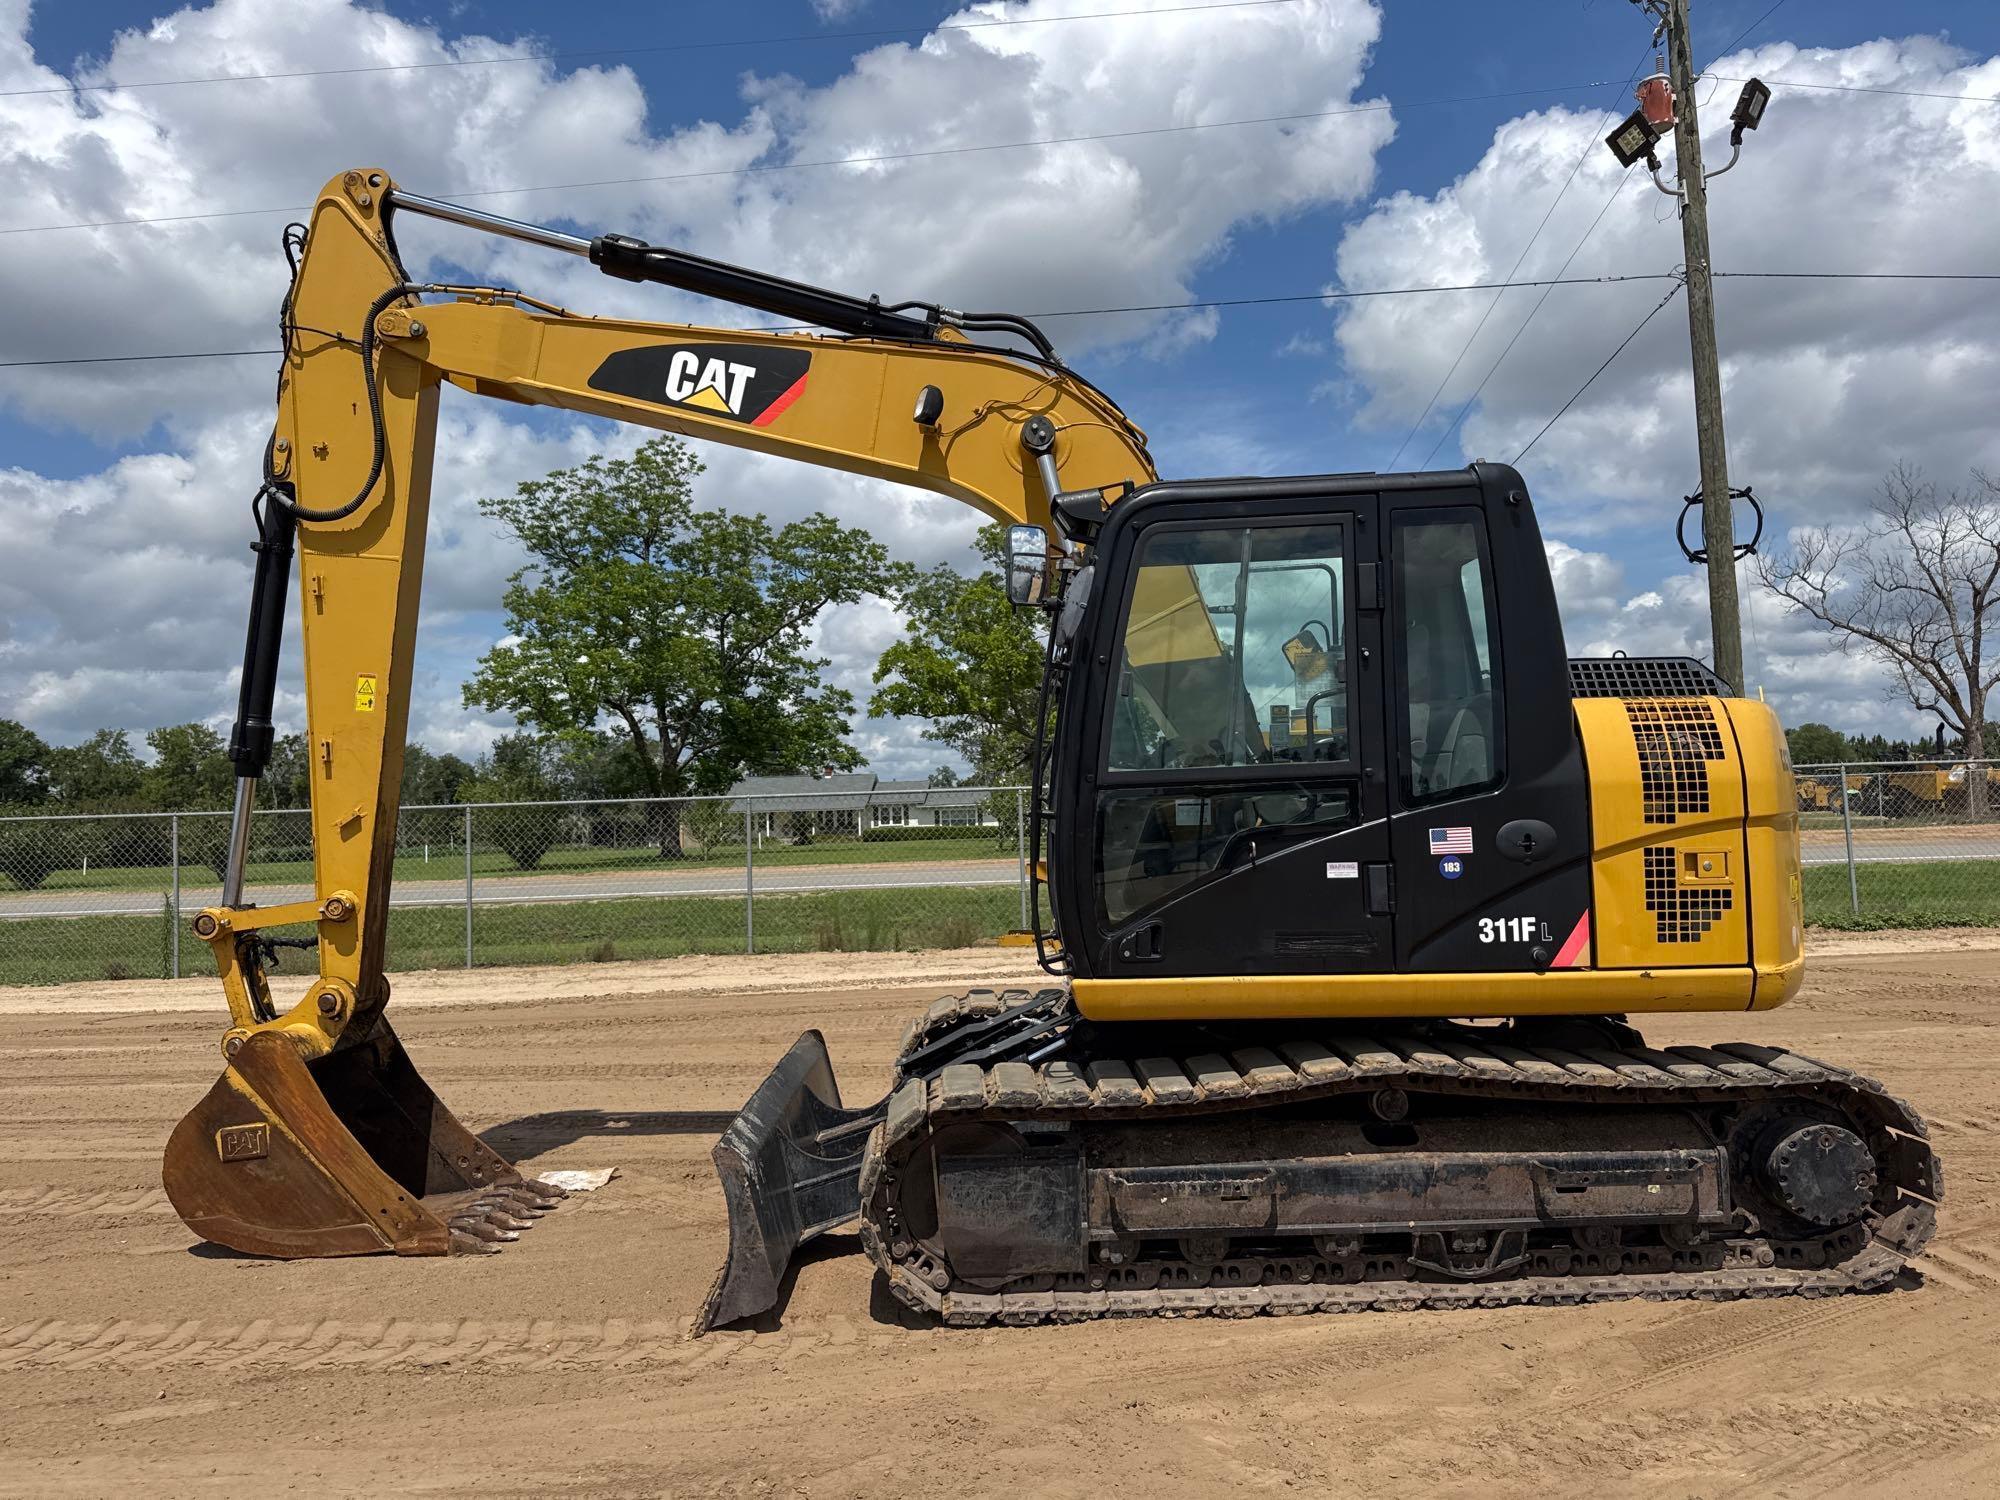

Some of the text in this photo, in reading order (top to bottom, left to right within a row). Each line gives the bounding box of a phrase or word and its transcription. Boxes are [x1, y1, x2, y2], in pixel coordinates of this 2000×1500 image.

[665, 351, 757, 415] CAT
[1443, 862, 1460, 872] 183
[1478, 917, 1553, 943] 311F L
[223, 1131, 262, 1156] CAT
